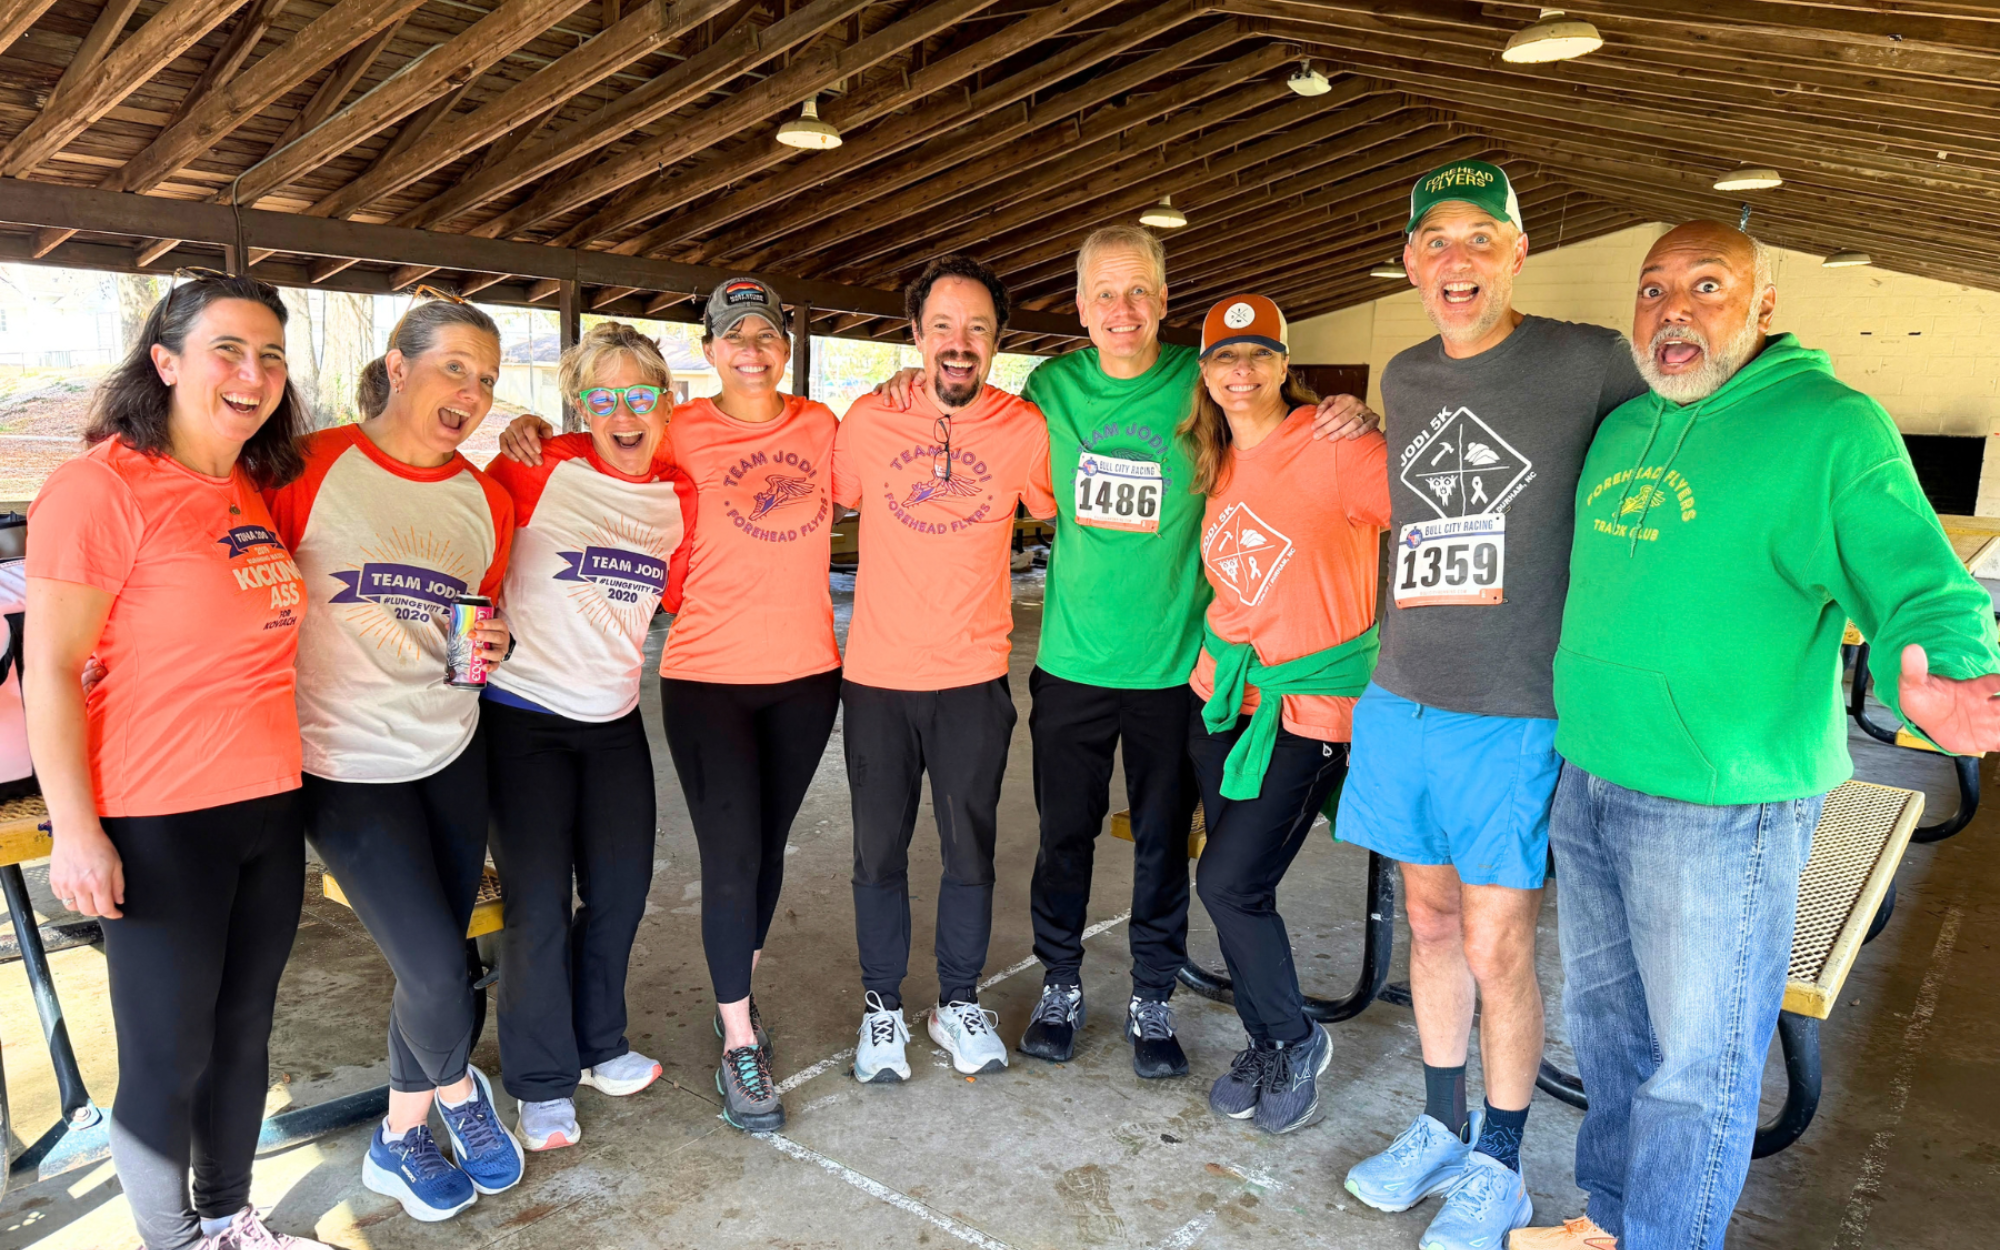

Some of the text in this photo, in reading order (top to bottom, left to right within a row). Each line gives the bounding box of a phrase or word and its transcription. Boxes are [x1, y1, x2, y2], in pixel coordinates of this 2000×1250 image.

[1425, 167, 1494, 191] FOREHEAD
[1431, 174, 1486, 193] FLYERS
[1126, 423, 1168, 455] JODI
[1400, 405, 1453, 467] JODI 5K
[723, 450, 817, 487] TEAM JODI
[951, 448, 992, 482] JODI
[1099, 461, 1155, 476] BULL CITY RACING
[1523, 471, 1537, 487] NC
[1078, 477, 1157, 518] 1486
[1663, 469, 1697, 522] FLYERS
[726, 497, 828, 542] FOREHEAD FLYERS
[884, 493, 947, 534] FOREHEAD
[1425, 519, 1494, 536] BULL CITY RACING
[592, 556, 664, 581] TEAM JODI
[1400, 542, 1498, 590] 1359
[371, 573, 421, 590] TEAM
[599, 578, 650, 593] #LUNGEVITY
[270, 582, 300, 610] ASS
[607, 588, 638, 603] 2020
[394, 607, 430, 623] 2020
